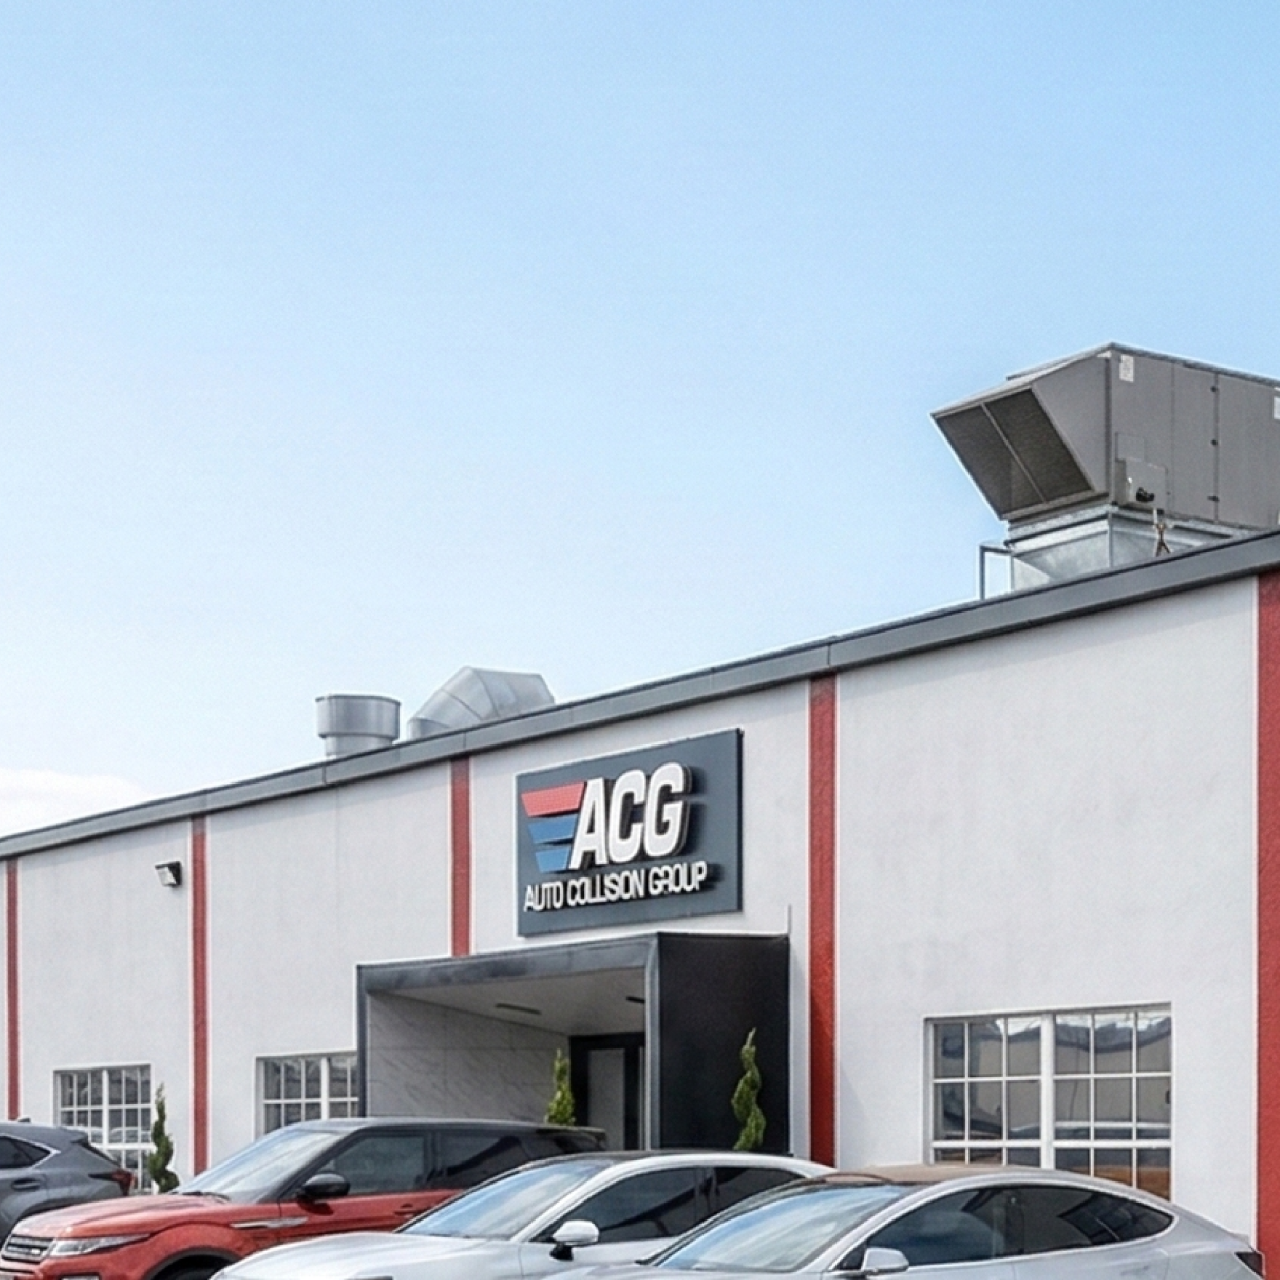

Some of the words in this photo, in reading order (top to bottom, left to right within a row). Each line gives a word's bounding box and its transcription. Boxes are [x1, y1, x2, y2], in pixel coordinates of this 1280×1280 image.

[568, 761, 687, 870] ACG
[523, 879, 563, 912] AUTO
[650, 860, 708, 896] GROUP
